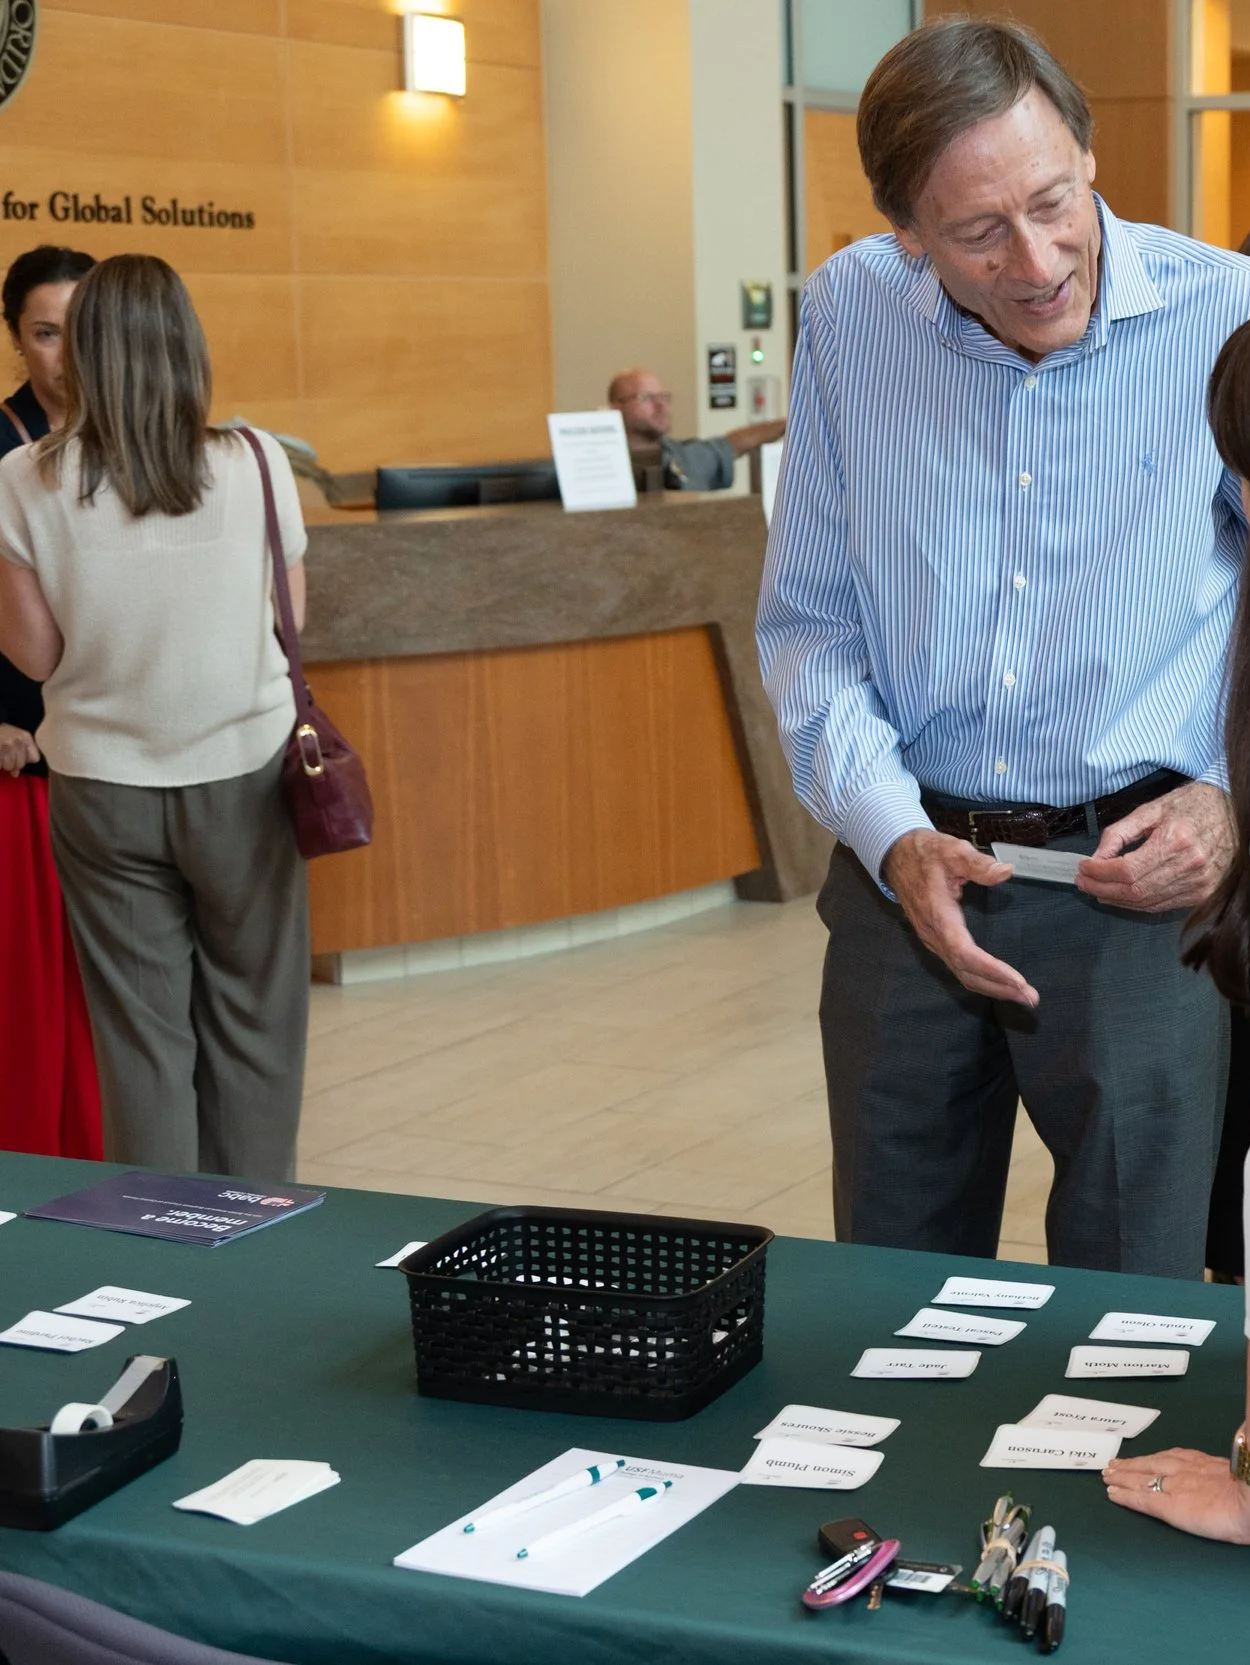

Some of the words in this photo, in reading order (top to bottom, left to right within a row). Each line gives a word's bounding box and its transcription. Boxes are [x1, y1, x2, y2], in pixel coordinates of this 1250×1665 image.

[2, 191, 39, 220] for
[49, 191, 133, 224] Global
[141, 196, 255, 229] Solutions
[217, 1190, 262, 1203] babc
[165, 1210, 248, 1225] member.
[155, 1216, 232, 1232] Become
[1121, 1319, 1157, 1327] Olson
[965, 1328, 1004, 1336] Pascal
[1053, 1411, 1087, 1420] Frost
[1090, 1416, 1127, 1425] Laura
[780, 1421, 833, 1433] Skoures
[835, 1428, 877, 1438] Bessie
[1008, 1446, 1065, 1456] Caruson
[1068, 1450, 1097, 1458] Kiki
[625, 1465, 650, 1473] USF
[766, 1459, 809, 1472] Plumb
[813, 1466, 856, 1477] Simon
